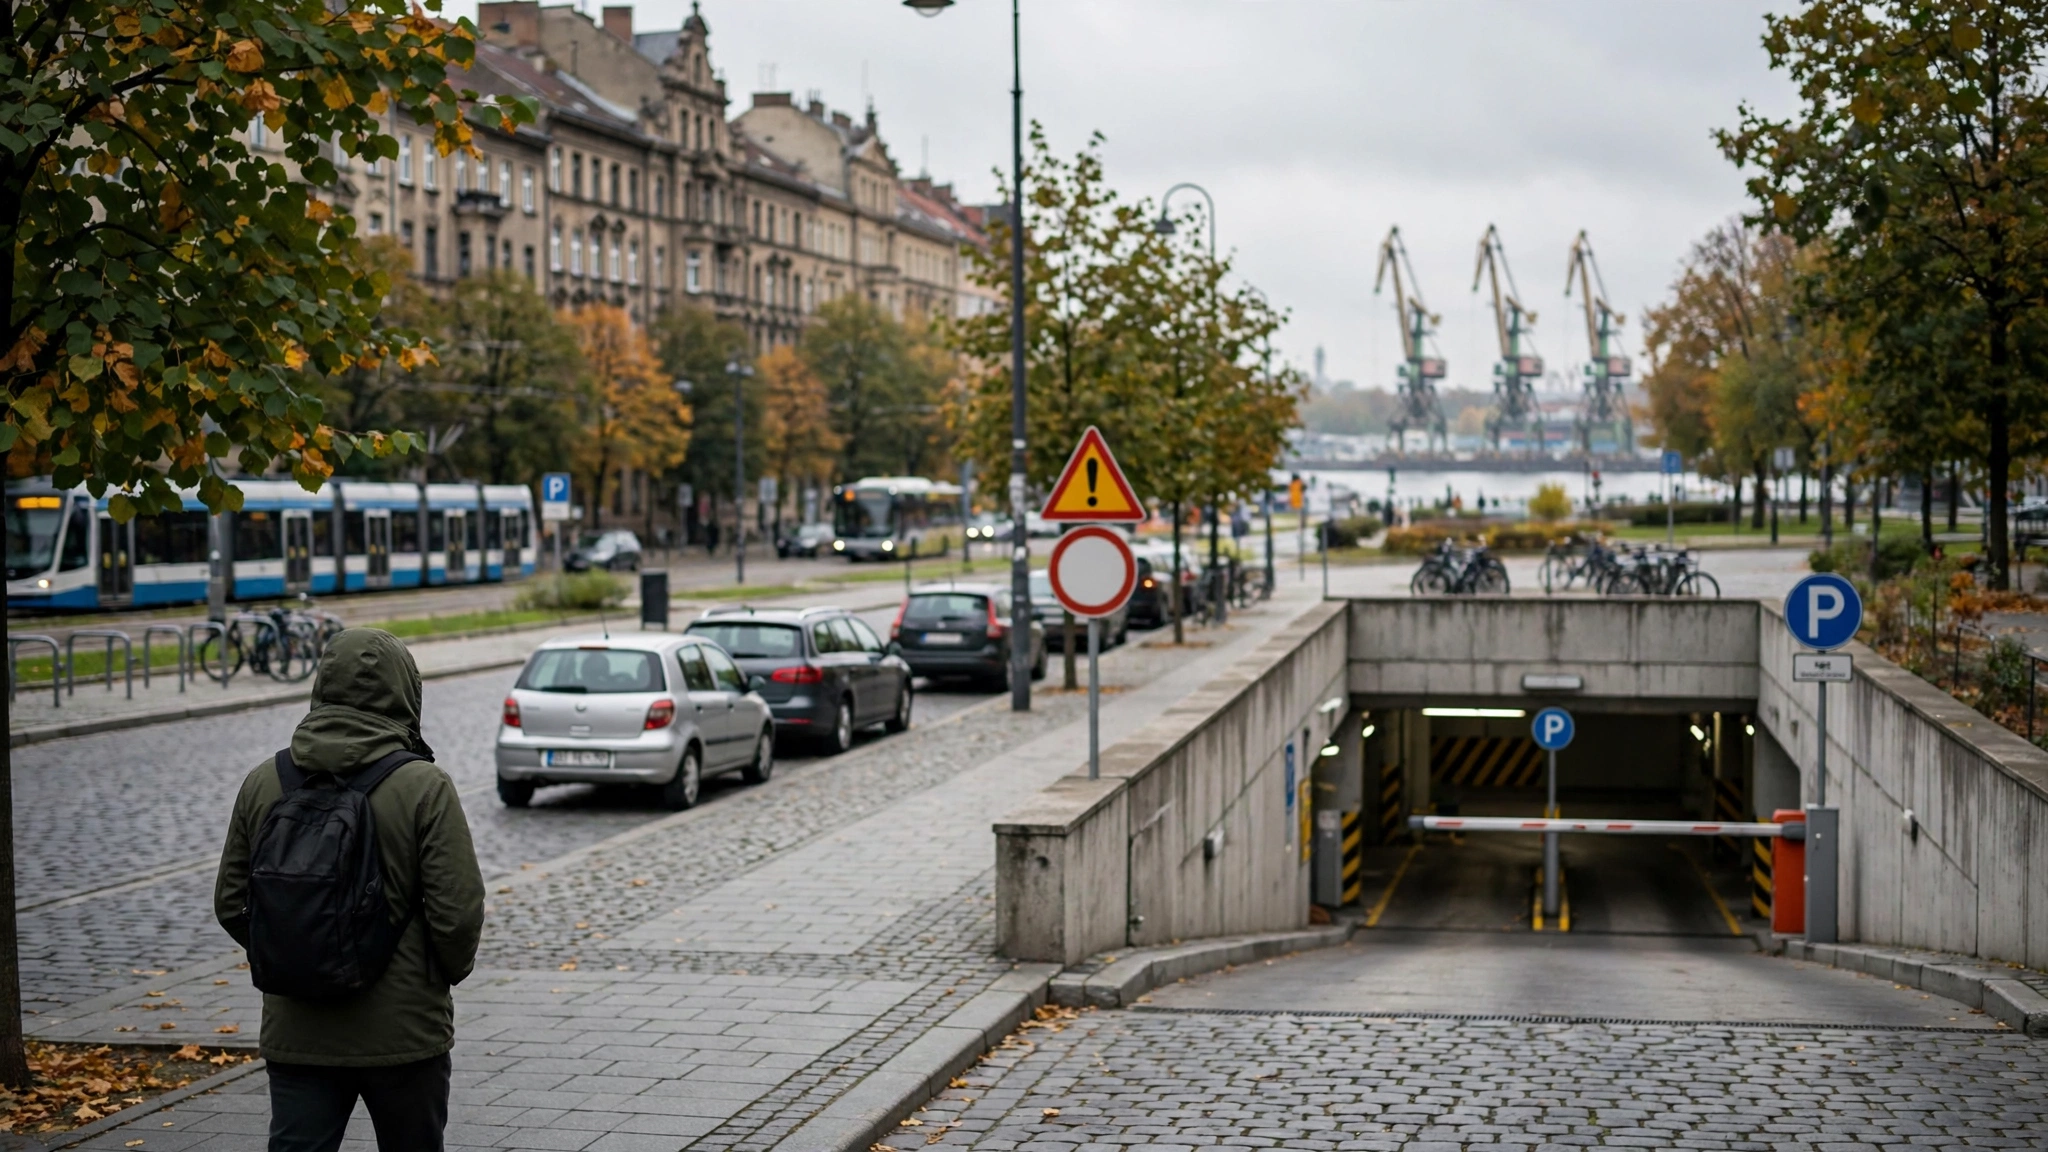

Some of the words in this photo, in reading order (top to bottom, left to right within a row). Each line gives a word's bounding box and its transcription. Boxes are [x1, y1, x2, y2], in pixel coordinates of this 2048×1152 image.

[549, 477, 565, 500] P
[1808, 585, 1845, 639] P
[1545, 714, 1565, 743] P
